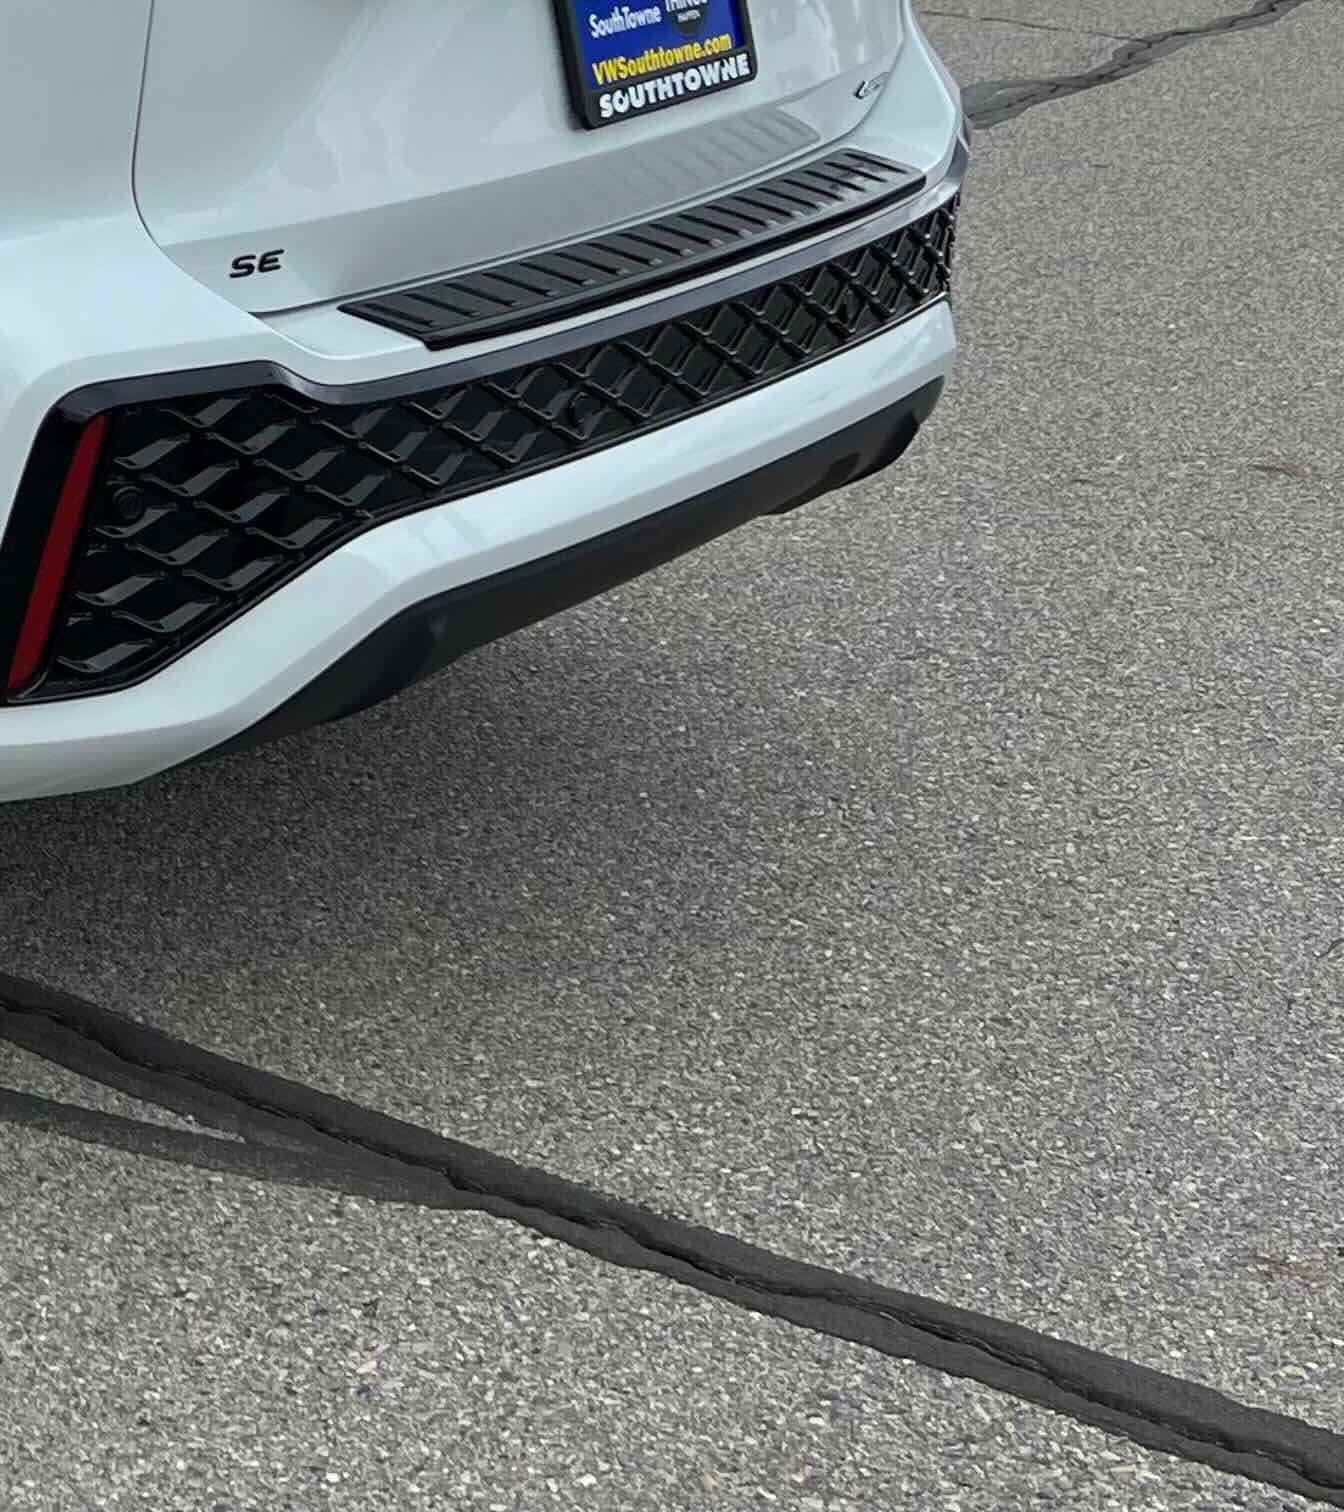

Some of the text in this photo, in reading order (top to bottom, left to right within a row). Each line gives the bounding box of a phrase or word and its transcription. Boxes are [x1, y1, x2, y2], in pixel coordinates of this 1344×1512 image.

[588, 5, 662, 38] SouthTowne
[591, 33, 732, 86] VWSouthtowne.com
[599, 53, 751, 119] SOUTHTOWNE
[229, 248, 285, 279] SE
